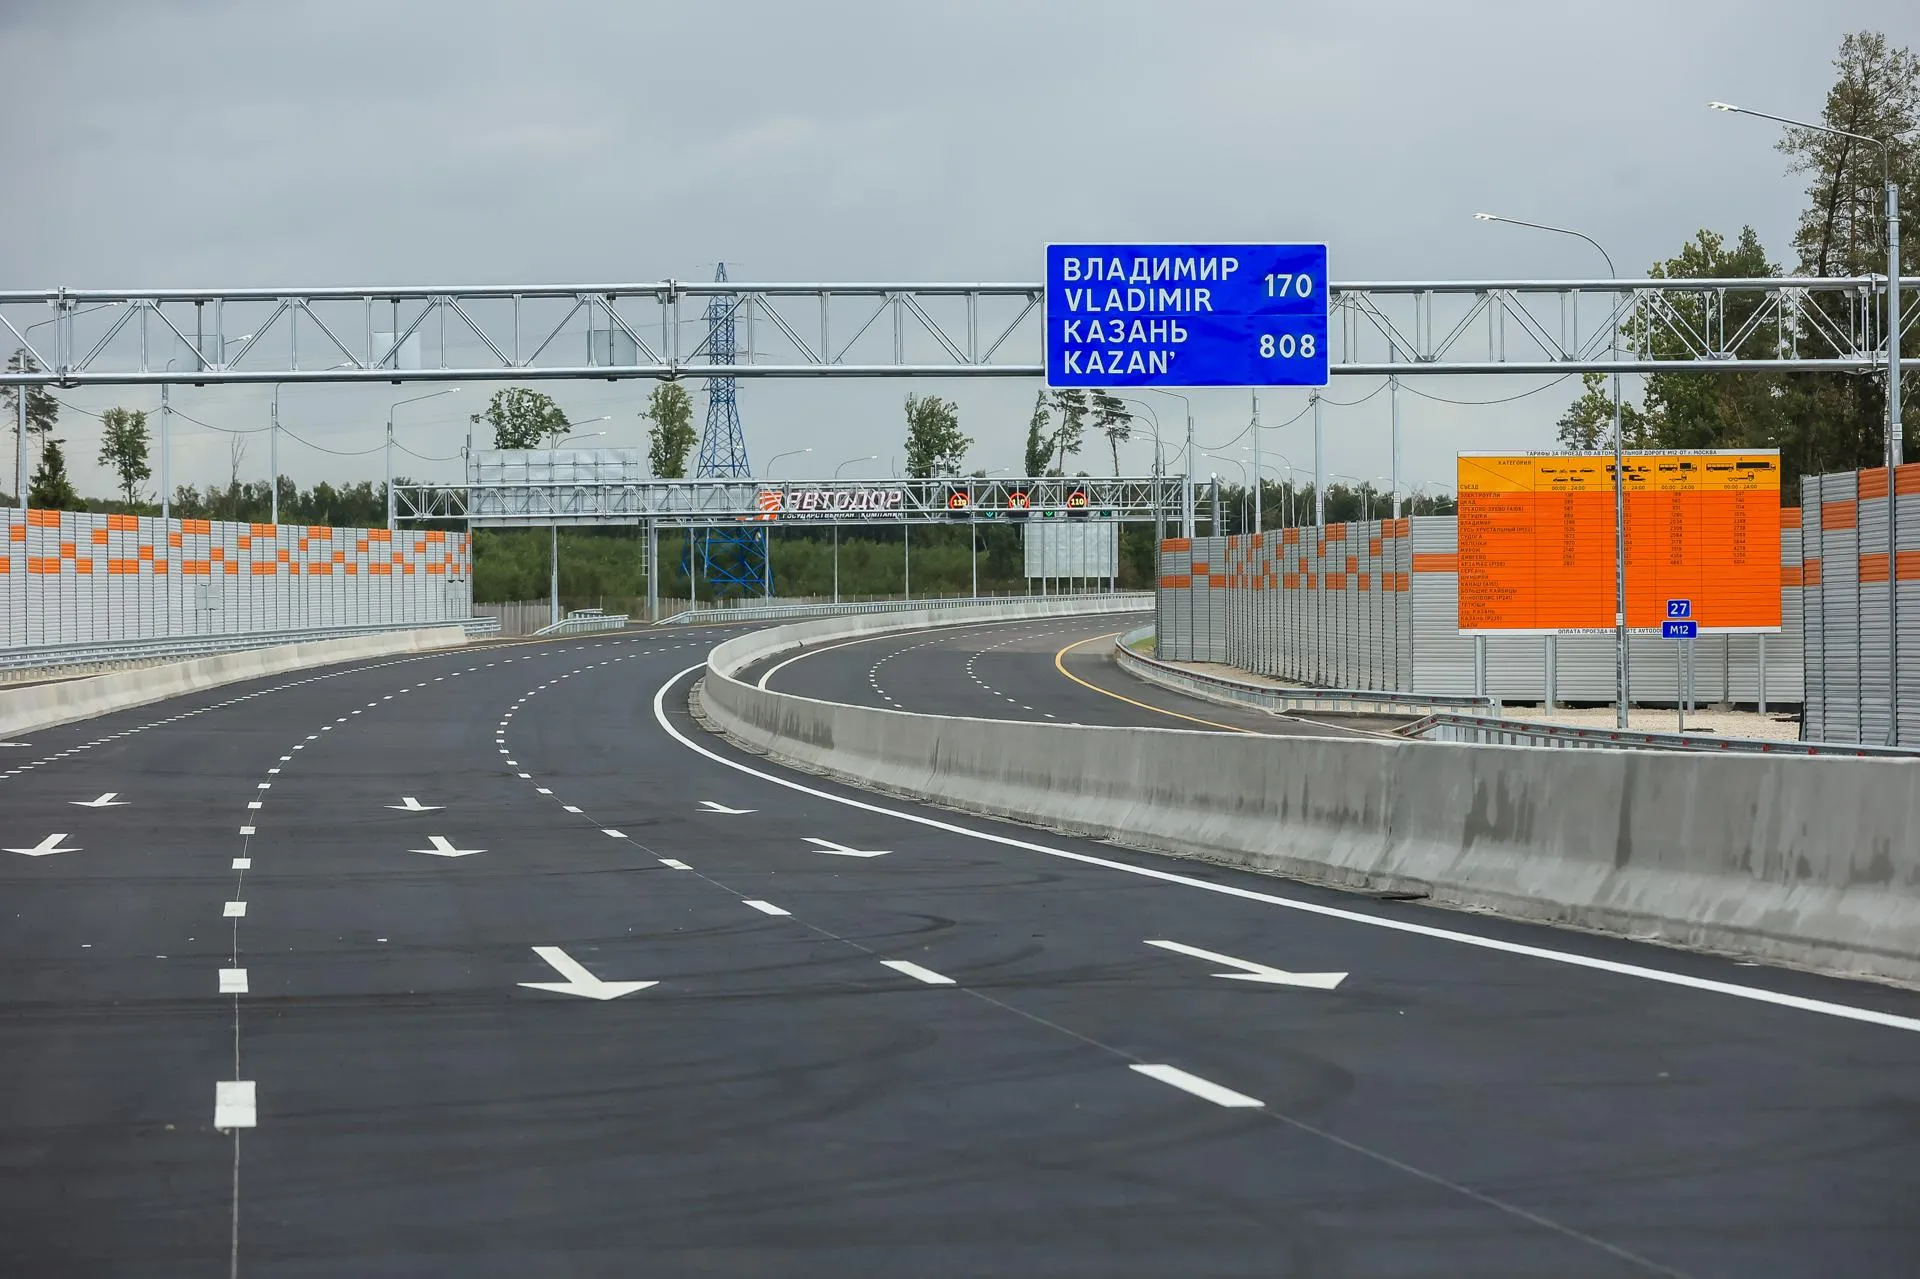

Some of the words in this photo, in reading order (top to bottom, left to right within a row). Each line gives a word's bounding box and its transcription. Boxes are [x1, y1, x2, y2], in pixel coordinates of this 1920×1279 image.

[1063, 257, 1239, 285] ВЛАДИМИР
[1264, 273, 1313, 297] 170
[1064, 288, 1213, 312] VLADIMIR
[1063, 319, 1188, 343] КАЗАНЬ
[1260, 334, 1316, 359] 808
[1063, 350, 1177, 374] KAZAN'
[787, 492, 902, 510] АВТОДОР
[1670, 603, 1687, 615] 27
[1670, 625, 1689, 634] M12
